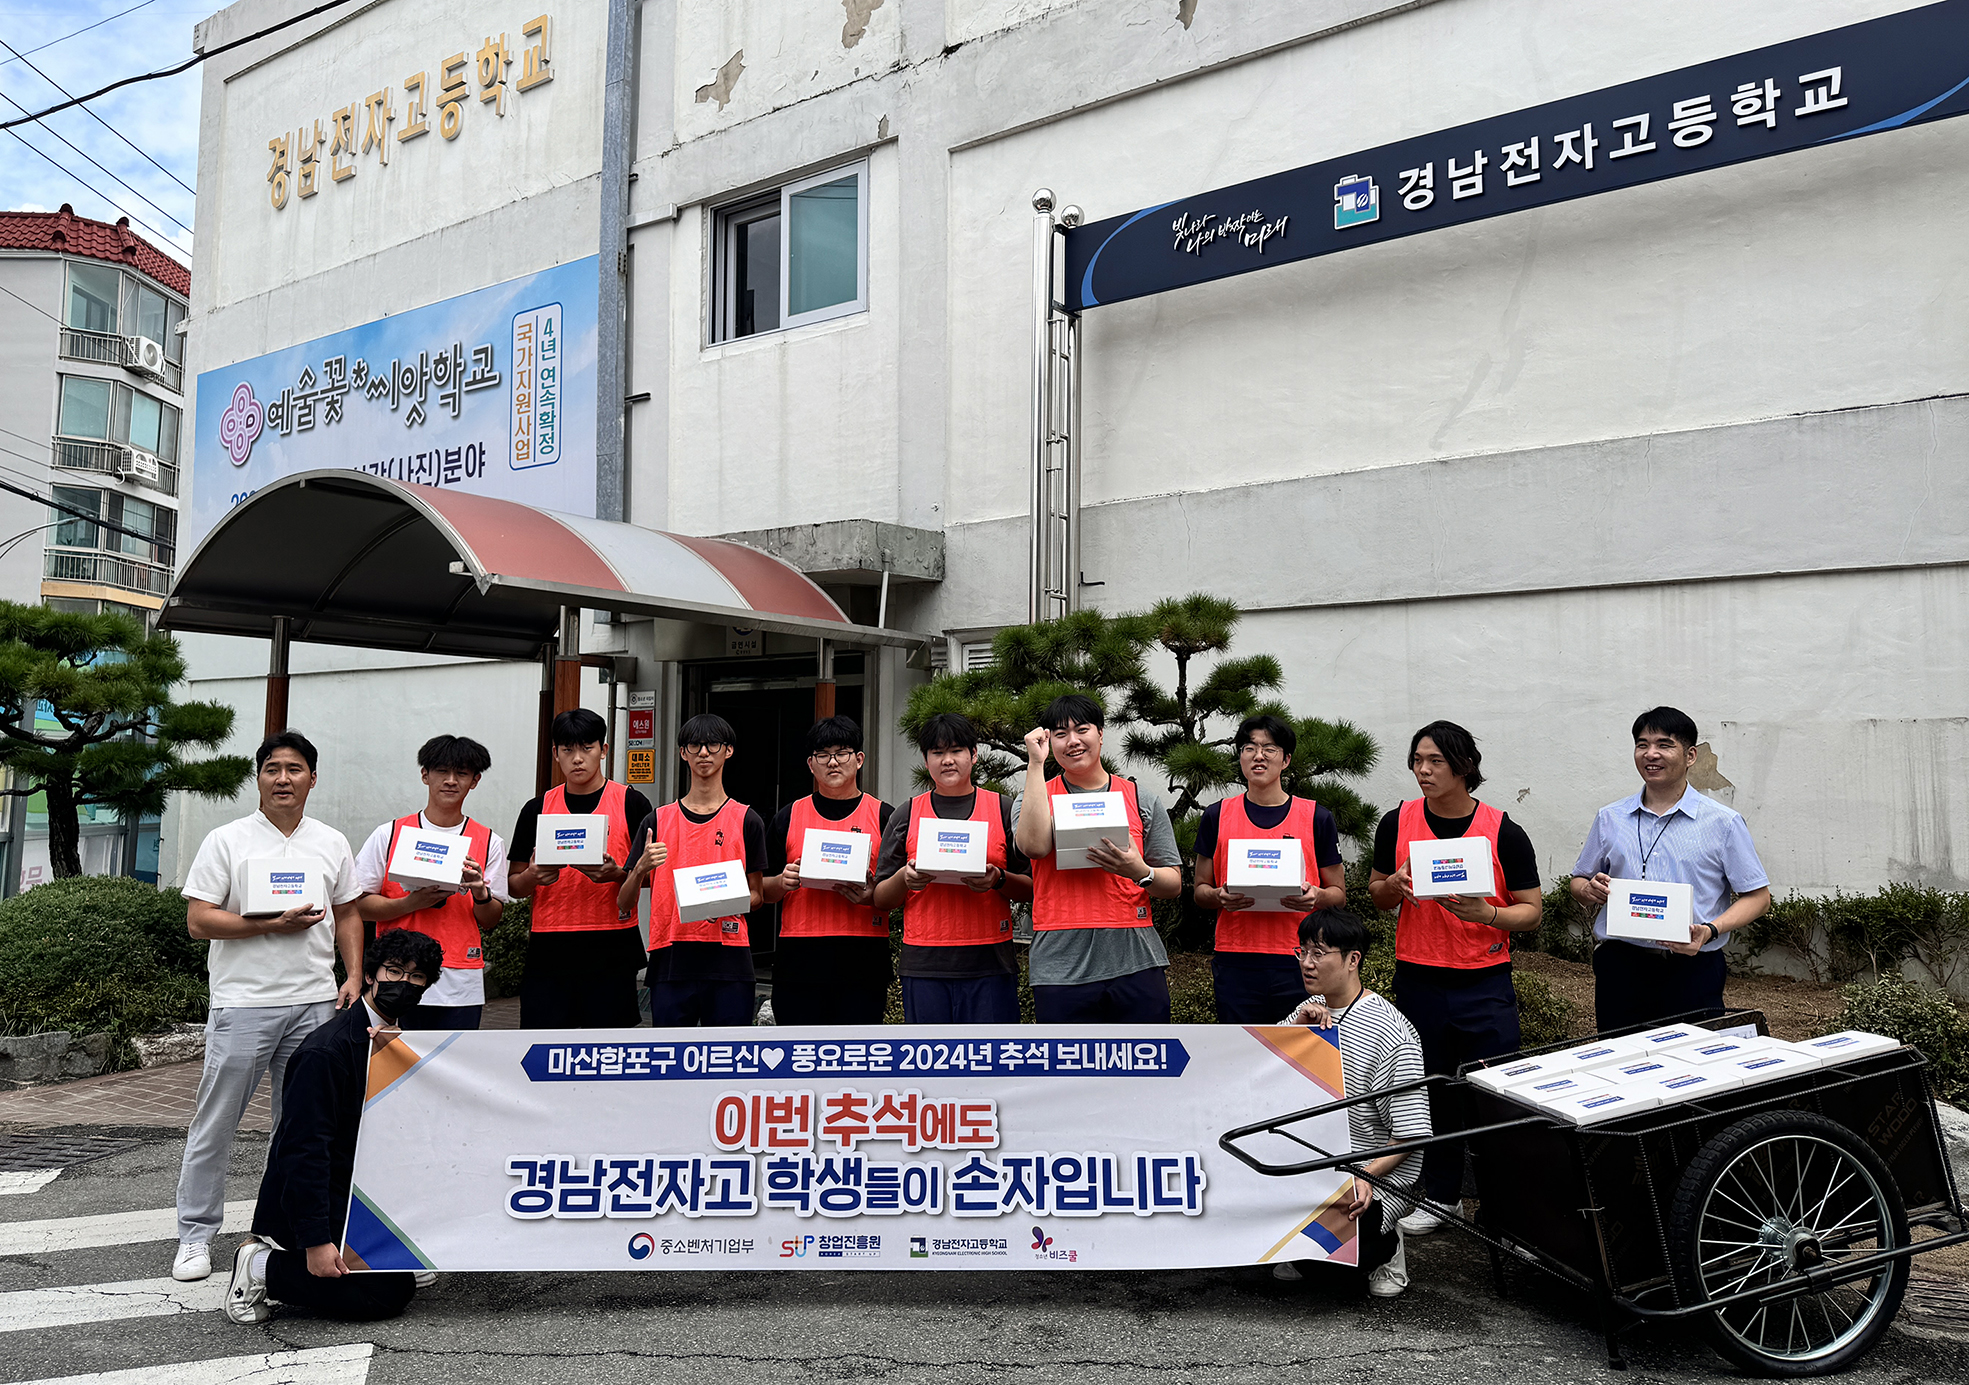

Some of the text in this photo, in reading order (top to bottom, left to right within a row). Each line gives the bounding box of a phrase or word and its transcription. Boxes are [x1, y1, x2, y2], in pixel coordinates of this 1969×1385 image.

[266, 14, 555, 210] 경남전자고등학교
[1396, 65, 1851, 213] 경남전자고등학교
[1244, 215, 1289, 254] 미래
[514, 323, 534, 462] 국가지원사업
[539, 317, 557, 455] 4년 연속확정
[548, 1045, 677, 1075] 마산합포구
[791, 1043, 894, 1073] 풍요로운
[898, 1043, 993, 1072] 2024년
[999, 1043, 1051, 1072] 추석
[1056, 1042, 1168, 1071] 보내세요!
[714, 1092, 995, 1148] 이번 추석에도
[1877, 1097, 1919, 1146] WOOD
[509, 1155, 1202, 1213] 경남전자고 학생들이 손자입니다
[660, 1237, 755, 1255] 중소벤처기업부
[818, 1235, 881, 1250] 창업진흥원
[932, 1238, 1008, 1250] 경남전자고등학교
[1049, 1250, 1078, 1262] 비즈쿨
